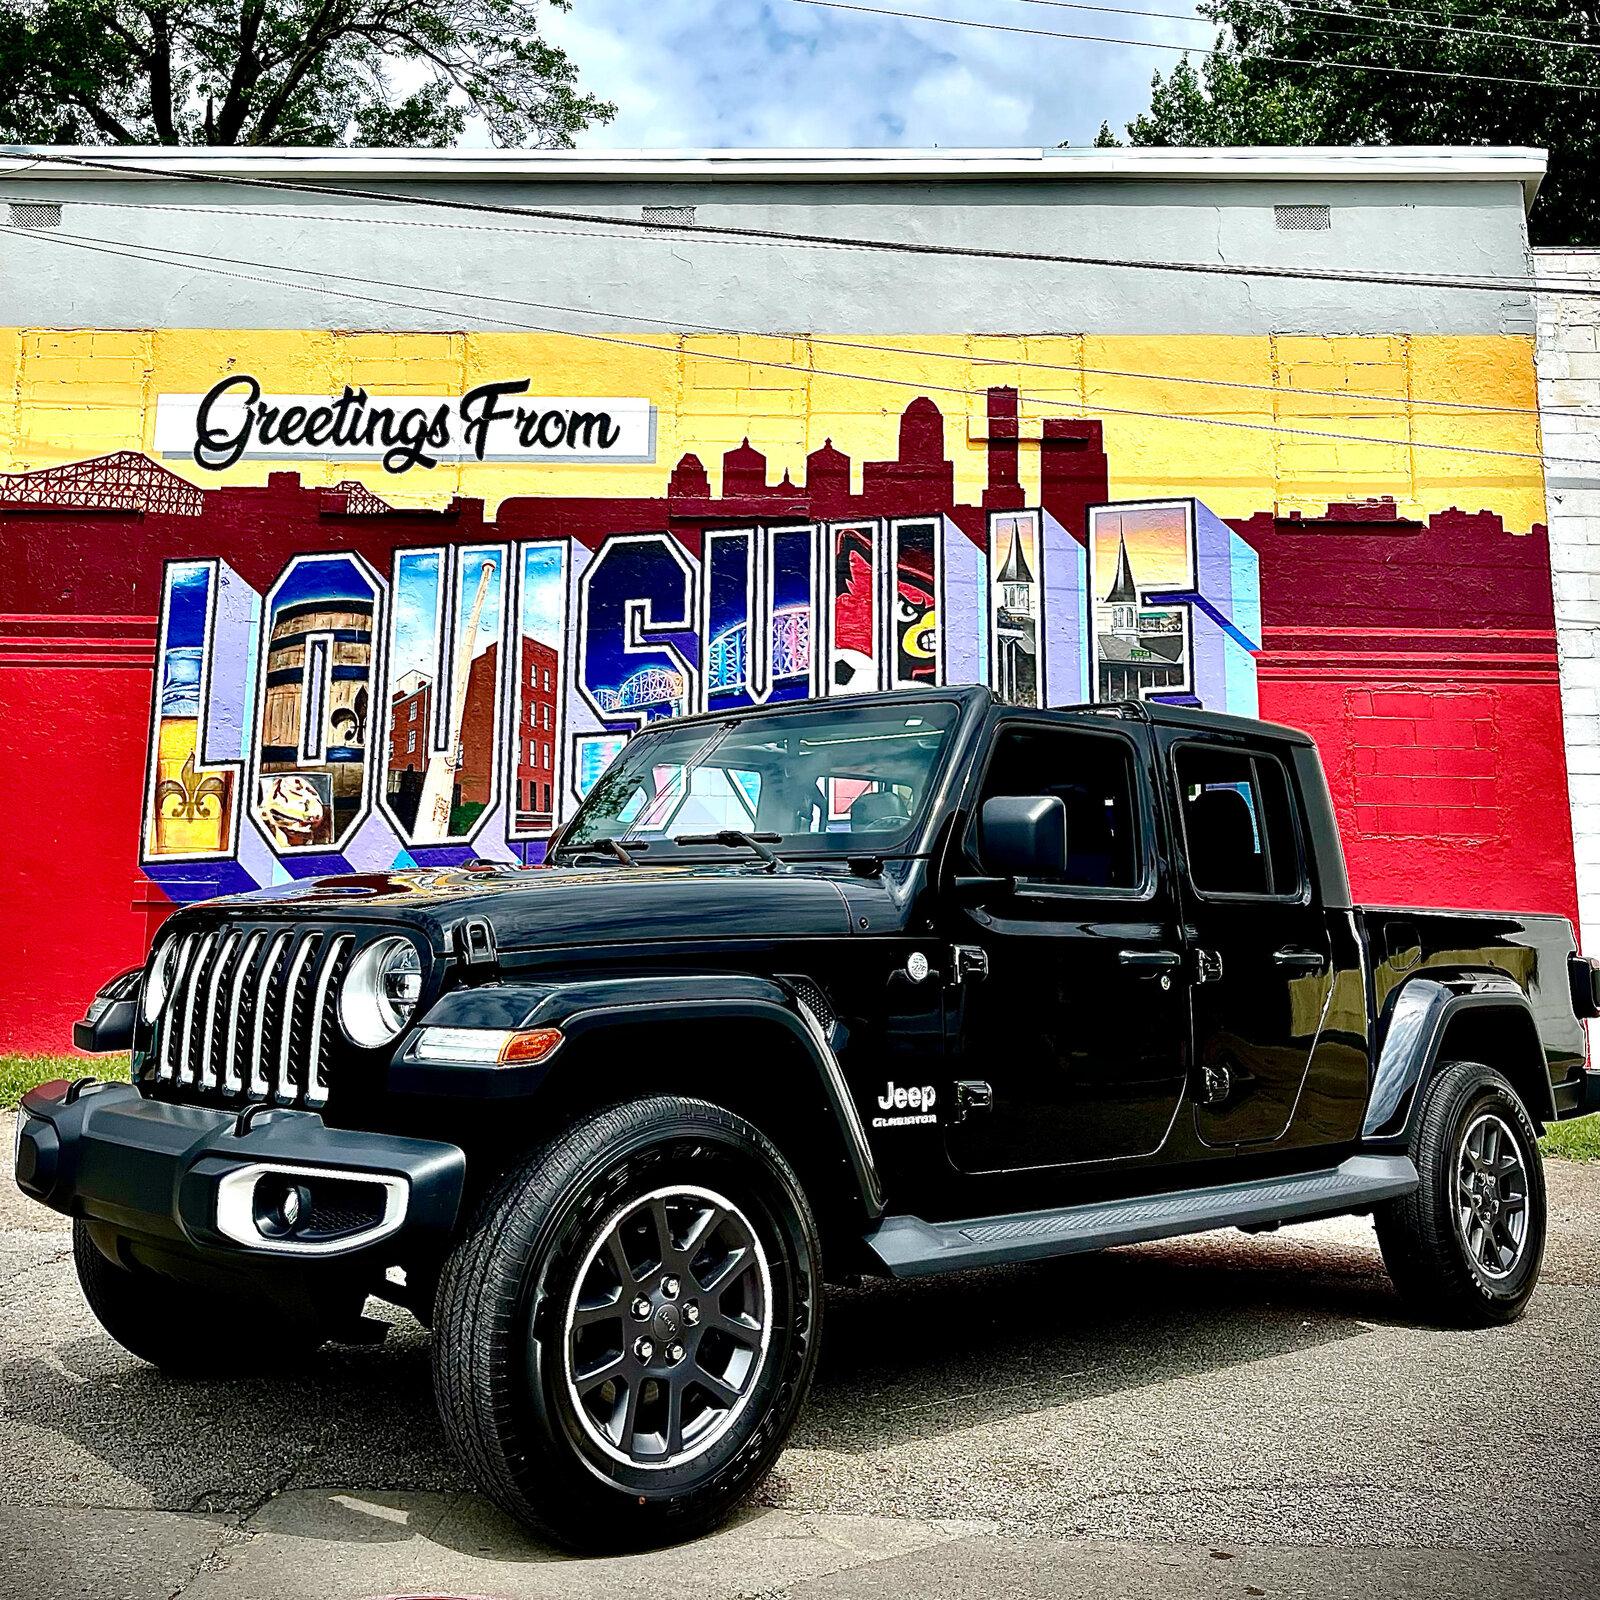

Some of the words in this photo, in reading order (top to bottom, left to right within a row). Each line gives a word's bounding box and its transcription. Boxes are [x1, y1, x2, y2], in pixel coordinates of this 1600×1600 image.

[194, 374, 452, 475] Greetings
[458, 377, 621, 461] From
[877, 1081, 937, 1113] Jeep
[872, 1114, 937, 1128] GLADIATOR
